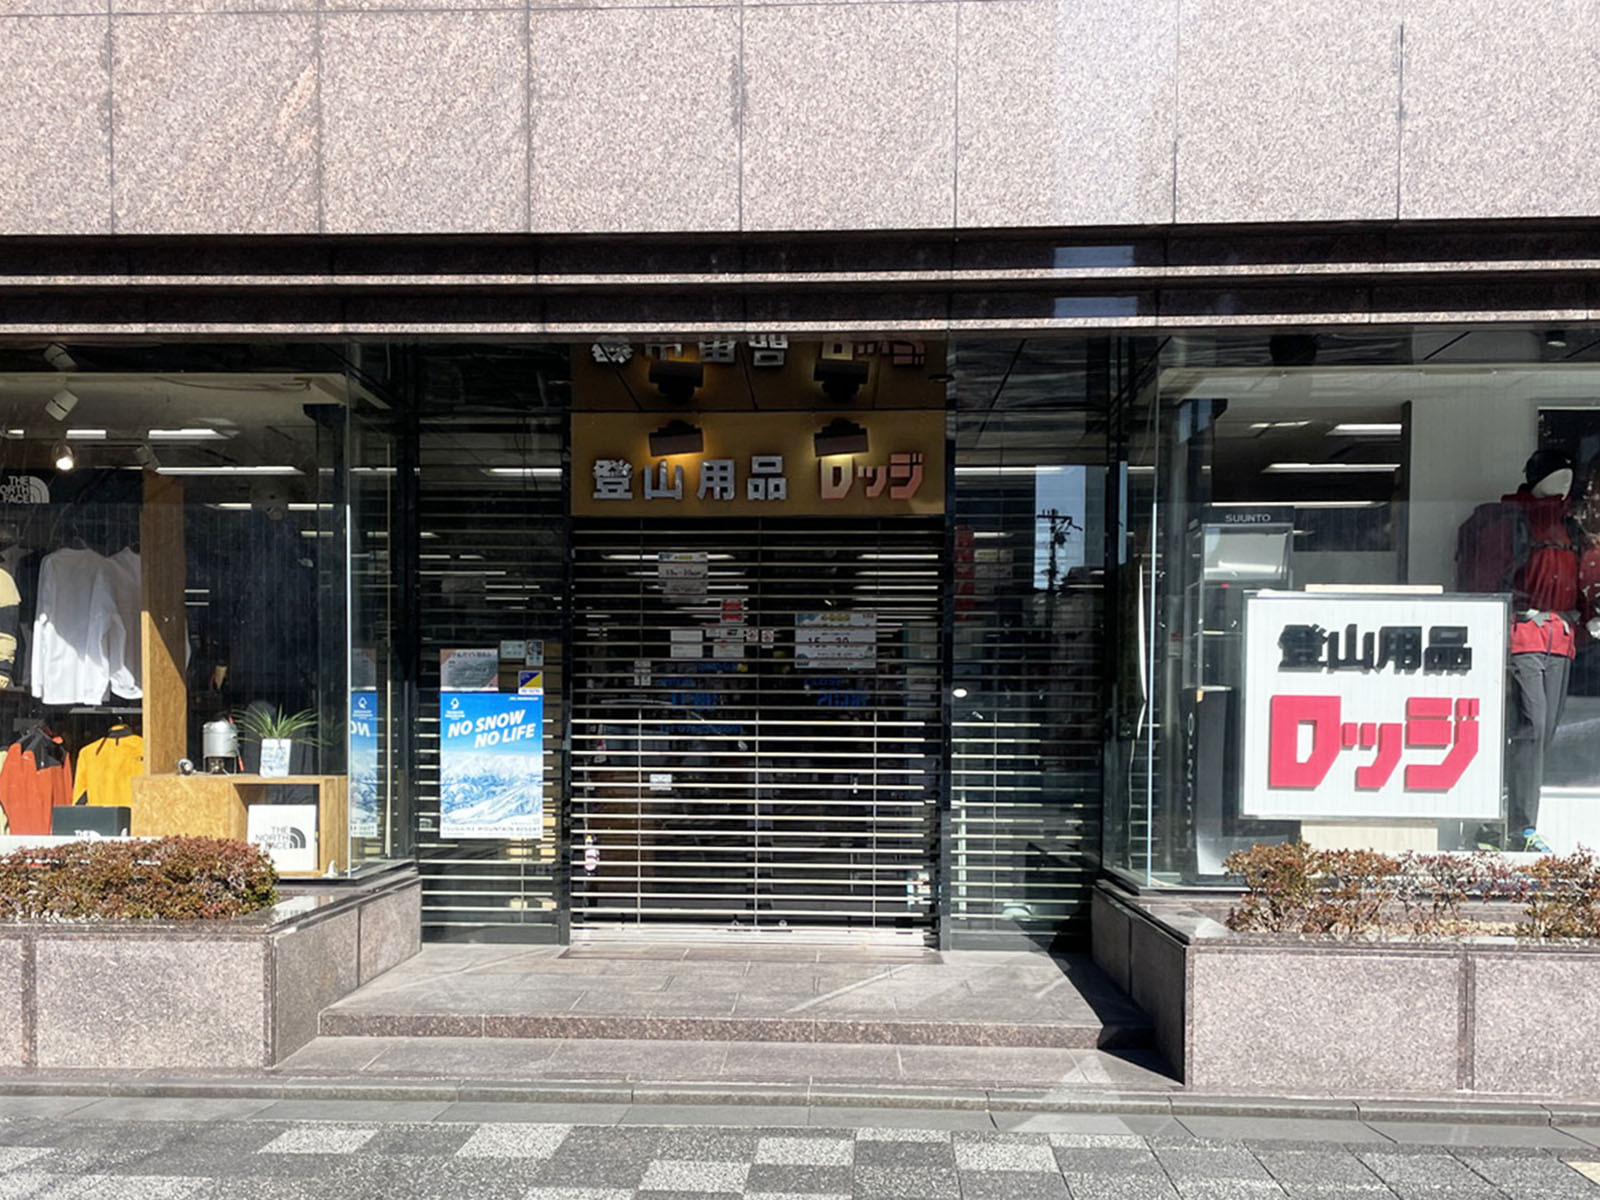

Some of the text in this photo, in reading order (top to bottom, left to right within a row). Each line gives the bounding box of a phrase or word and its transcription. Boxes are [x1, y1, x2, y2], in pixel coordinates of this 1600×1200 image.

[8, 475, 29, 485] THE
[592, 453, 924, 501] 登山用品 ロッジ
[3, 495, 30, 504] FACE
[1225, 513, 1271, 523] SUUNTO
[1277, 623, 1473, 675] 登山用品
[447, 720, 473, 738] NO
[475, 709, 526, 733] SNOW
[474, 723, 537, 749] NO LIFE
[1268, 694, 1480, 792] ロッジ
[255, 834, 289, 842] NORTH
[271, 826, 287, 834] THE
